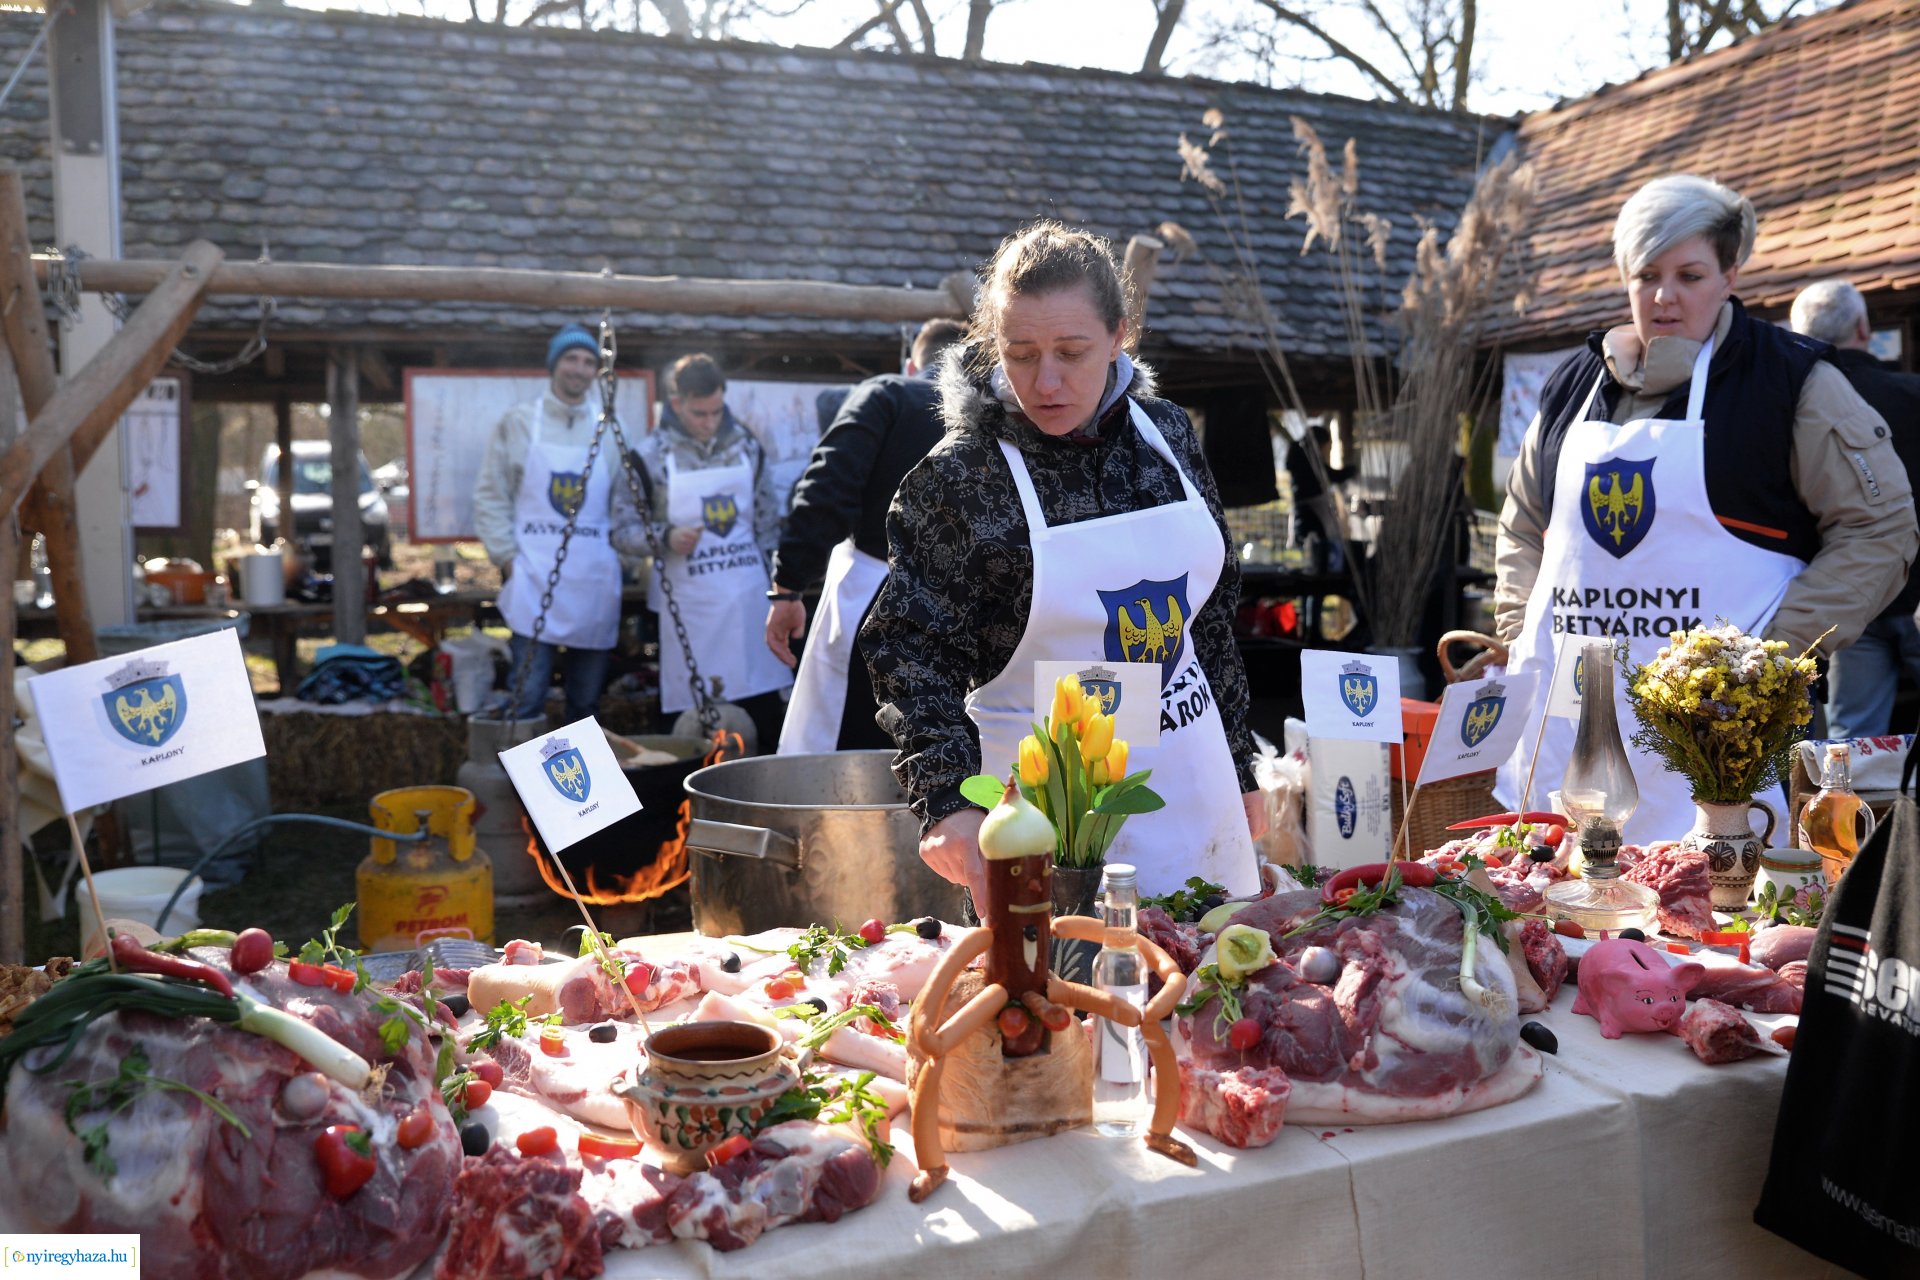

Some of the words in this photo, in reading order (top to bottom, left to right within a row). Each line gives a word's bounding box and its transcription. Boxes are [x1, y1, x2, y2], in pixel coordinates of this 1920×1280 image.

[1552, 587, 1700, 609] KAPLONYI
[1553, 611, 1702, 638] BETYÁROK
[141, 746, 185, 765] KAPLONY
